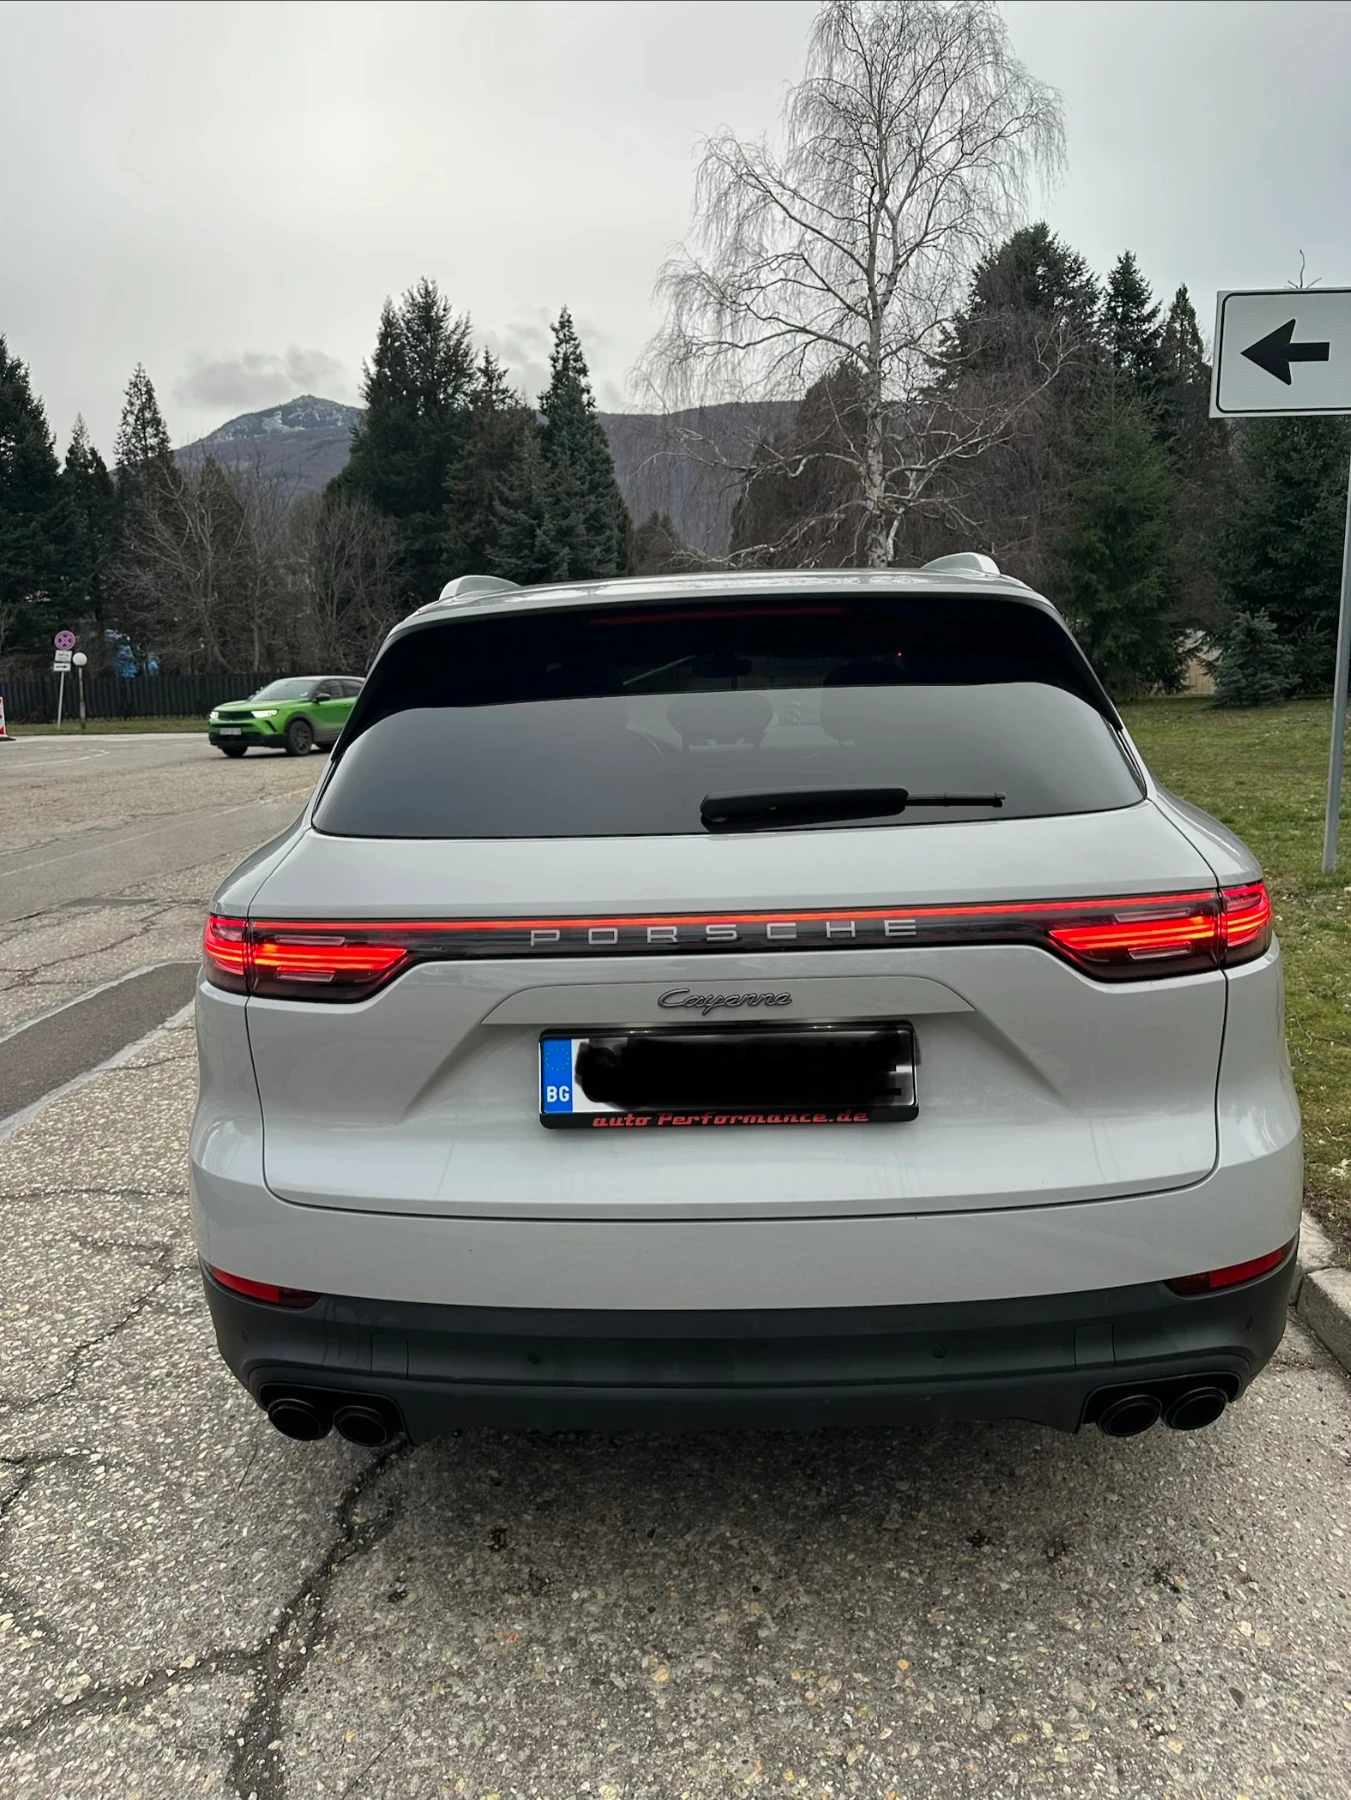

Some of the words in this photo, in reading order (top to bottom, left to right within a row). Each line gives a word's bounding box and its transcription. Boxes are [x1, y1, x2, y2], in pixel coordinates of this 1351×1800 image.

[530, 919, 917, 946] PORSCHE
[657, 987, 793, 1016] Cayenne
[546, 1085, 570, 1102] BG
[592, 1113, 652, 1127] auto
[657, 1110, 869, 1126] Performance.de
